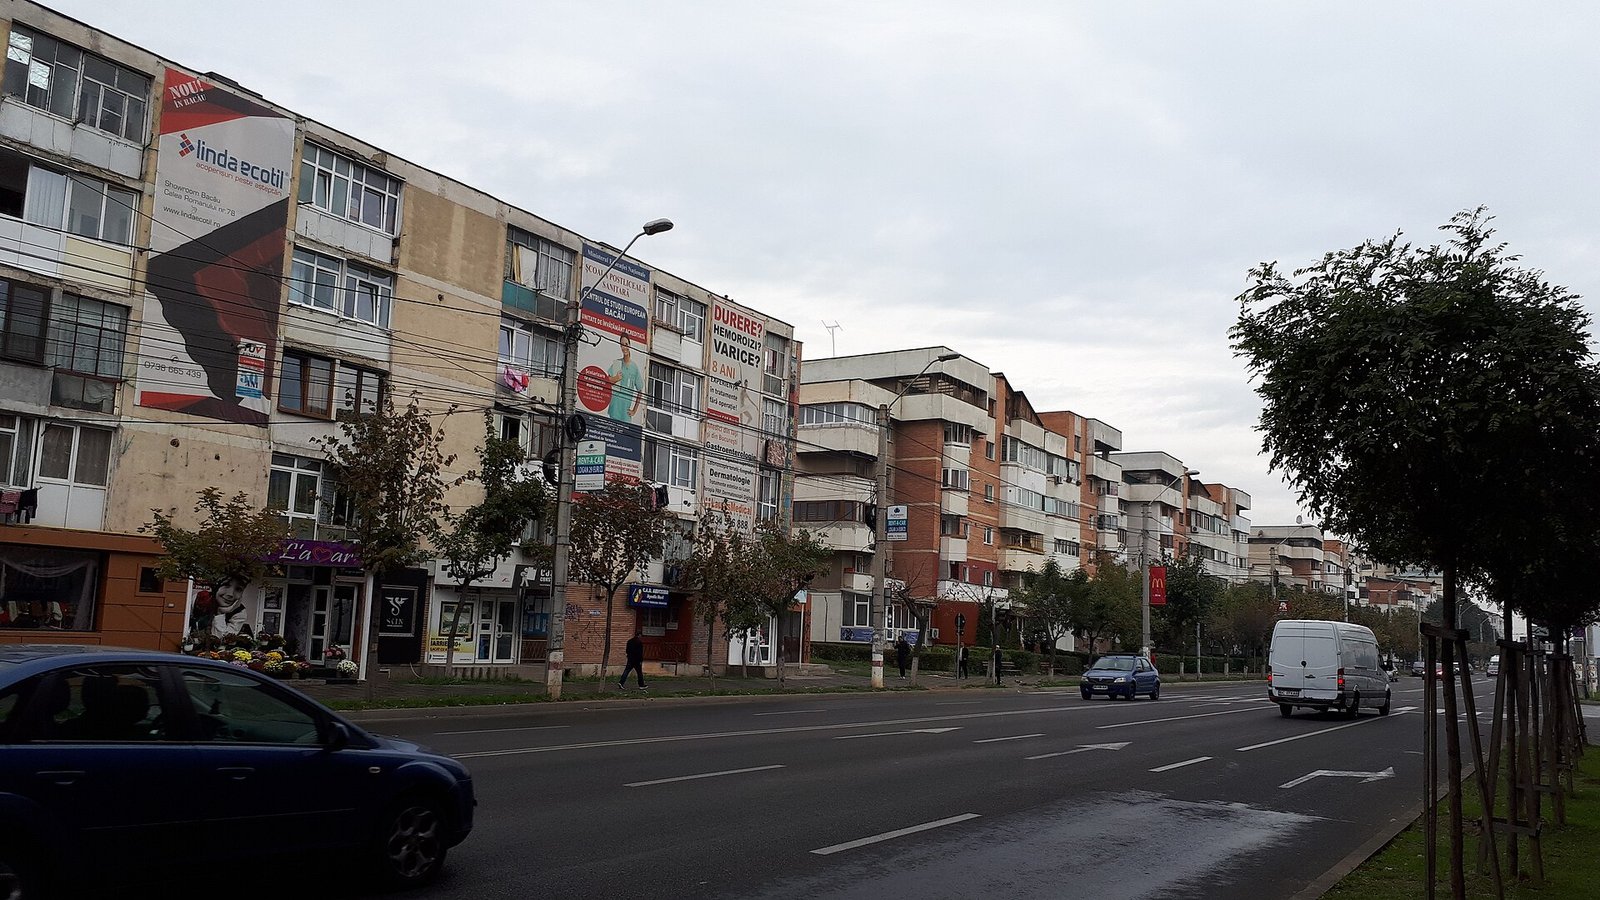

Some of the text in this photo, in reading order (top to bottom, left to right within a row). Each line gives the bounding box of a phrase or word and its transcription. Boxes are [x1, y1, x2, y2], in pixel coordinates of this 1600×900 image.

[168, 79, 204, 99] NOU!
[184, 93, 208, 106] BACĂU
[196, 139, 284, 189] linda ecotil
[164, 180, 221, 204] Showroom Bacău
[163, 205, 221, 228] www.lindaecotil.ro
[602, 281, 630, 298] SANITARĂ
[604, 297, 610, 306] DE
[604, 307, 626, 321] BACĂU
[714, 304, 763, 339] DURERE?
[713, 323, 762, 351] HEMOROIZI?
[713, 338, 761, 368] VARICE?
[712, 360, 736, 379] 8 ANI
[714, 387, 738, 401] tratamente
[706, 441, 757, 460] Gastroenterologie
[709, 468, 751, 486] Dermatologie
